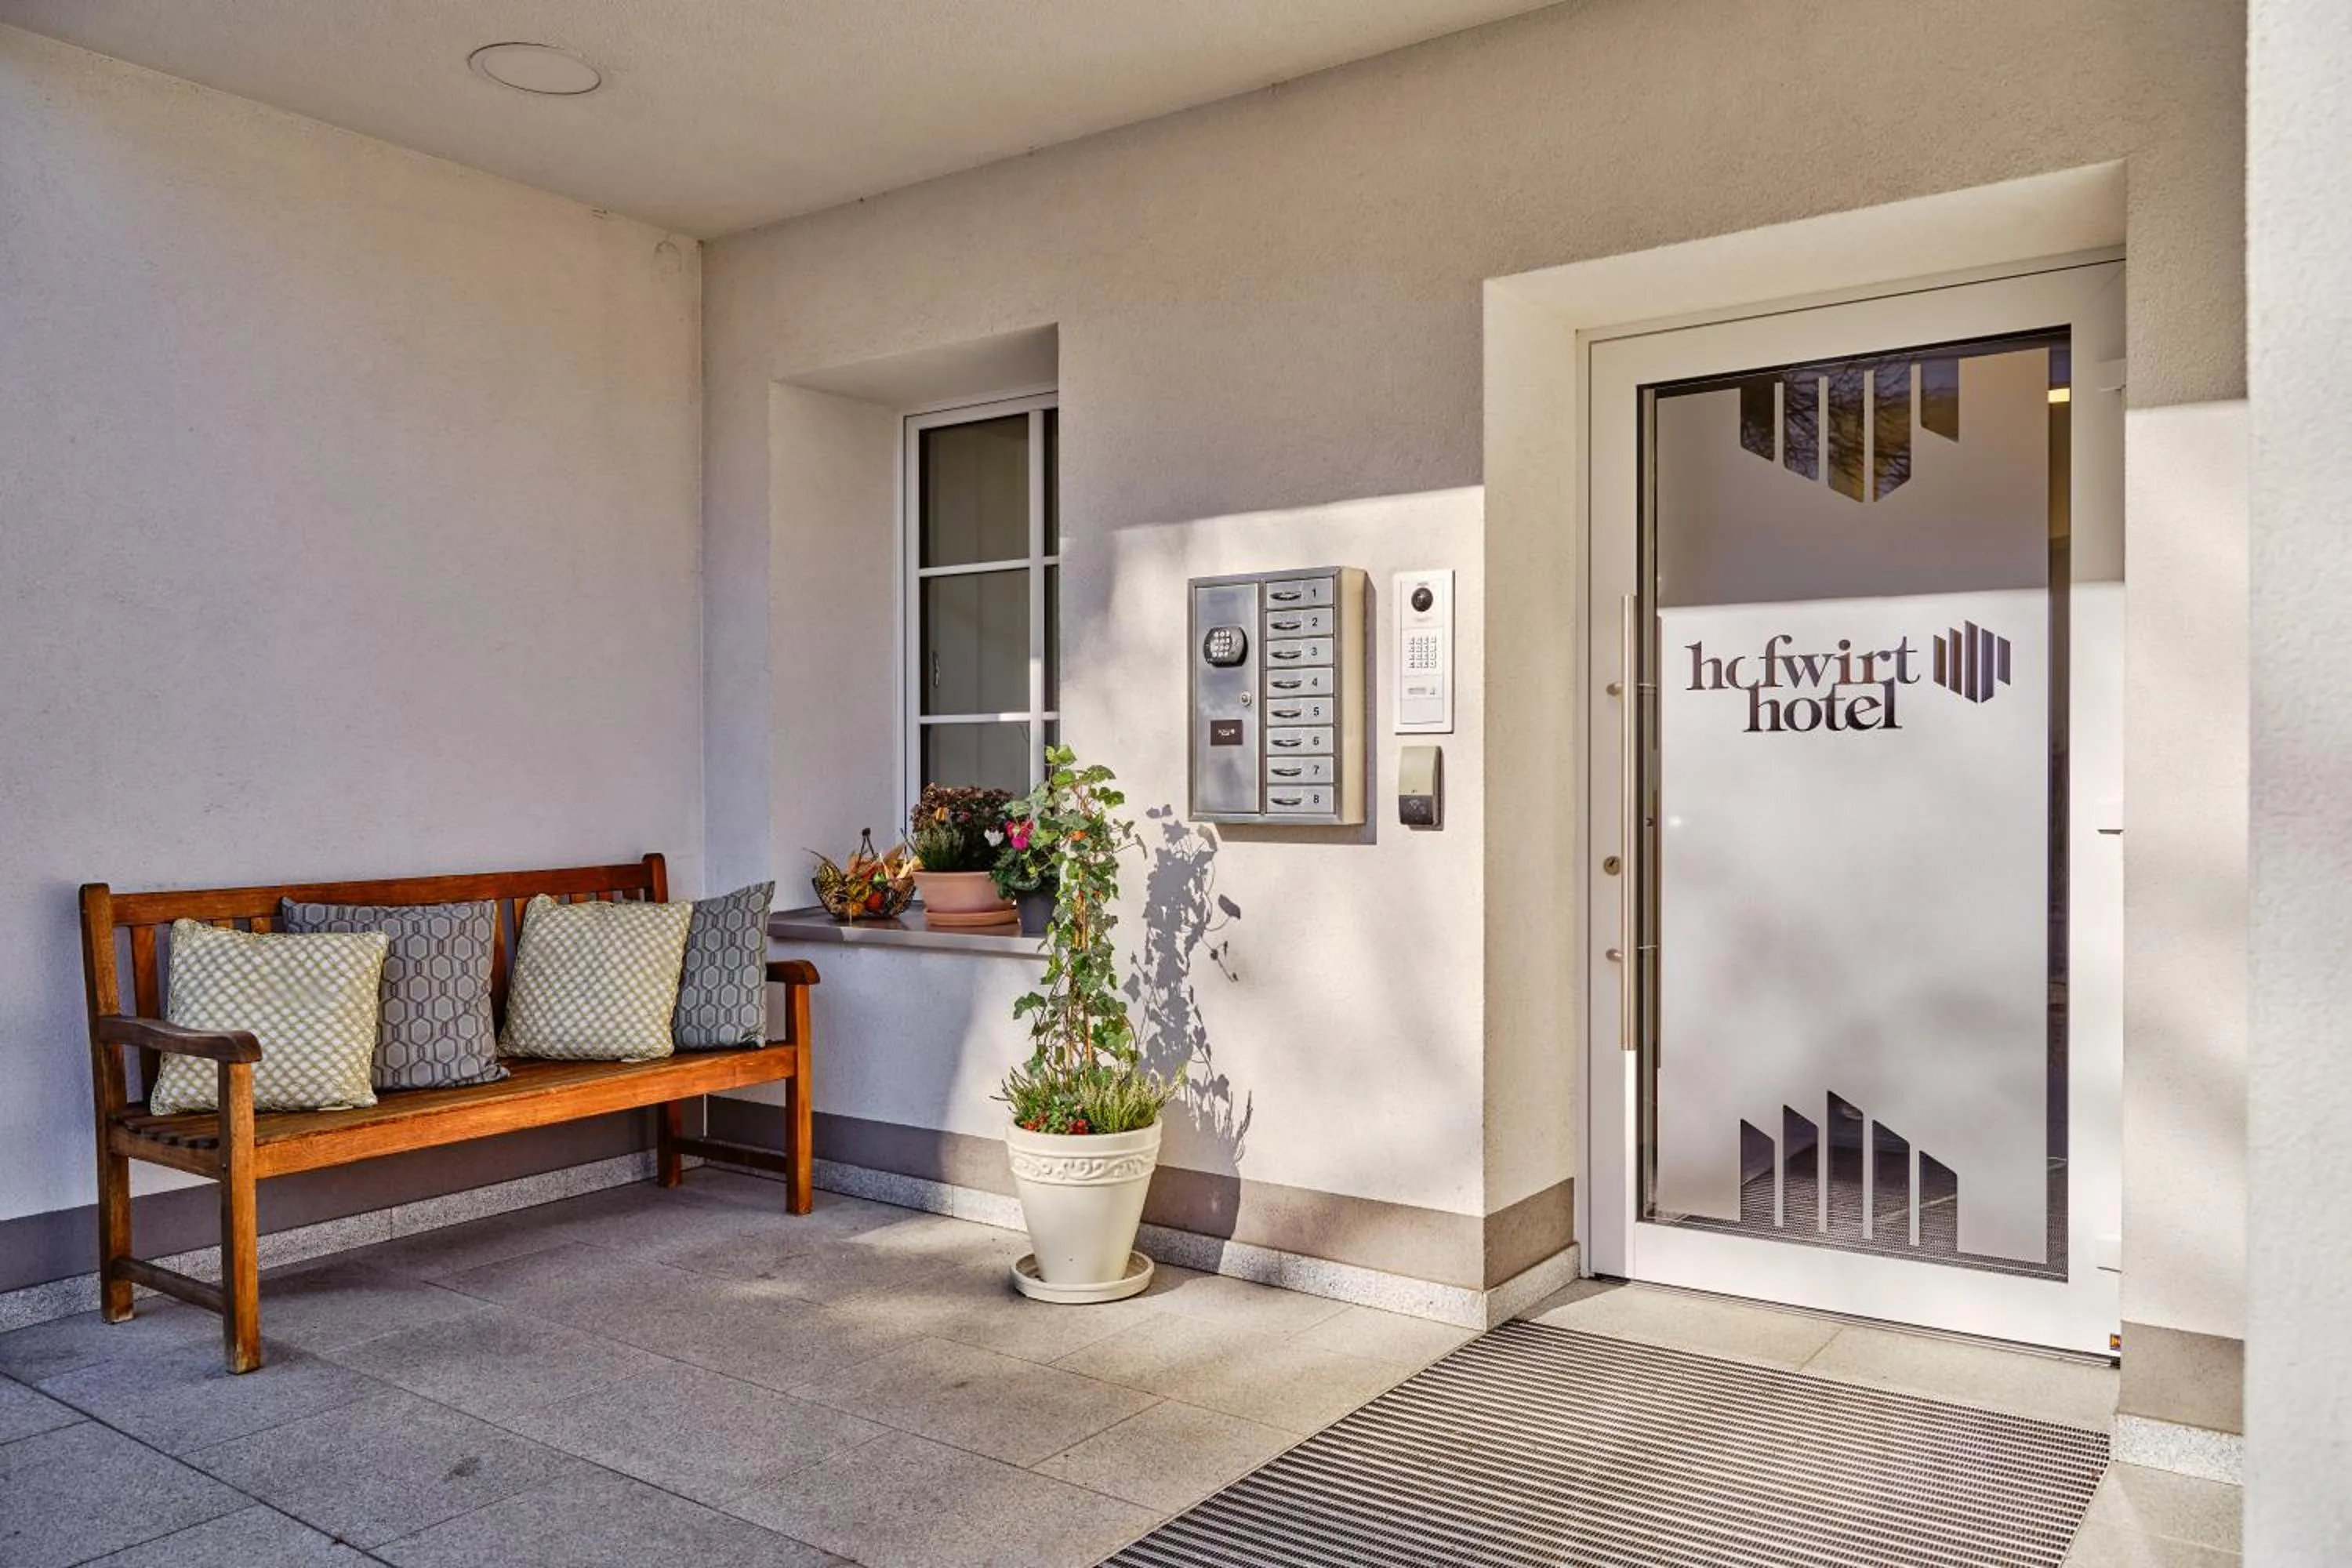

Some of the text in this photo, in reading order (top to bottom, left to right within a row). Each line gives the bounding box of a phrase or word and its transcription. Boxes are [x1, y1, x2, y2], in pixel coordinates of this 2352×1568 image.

[1312, 588, 1316, 597] 1
[1312, 617, 1318, 626] 2
[1311, 647, 1318, 656] 3
[1312, 677, 1318, 687] 4
[1743, 677, 1903, 733] hotel
[1313, 706, 1319, 717] 5
[1312, 736, 1319, 746] 6
[1313, 764, 1319, 775] 7
[1313, 794, 1319, 804] 8
